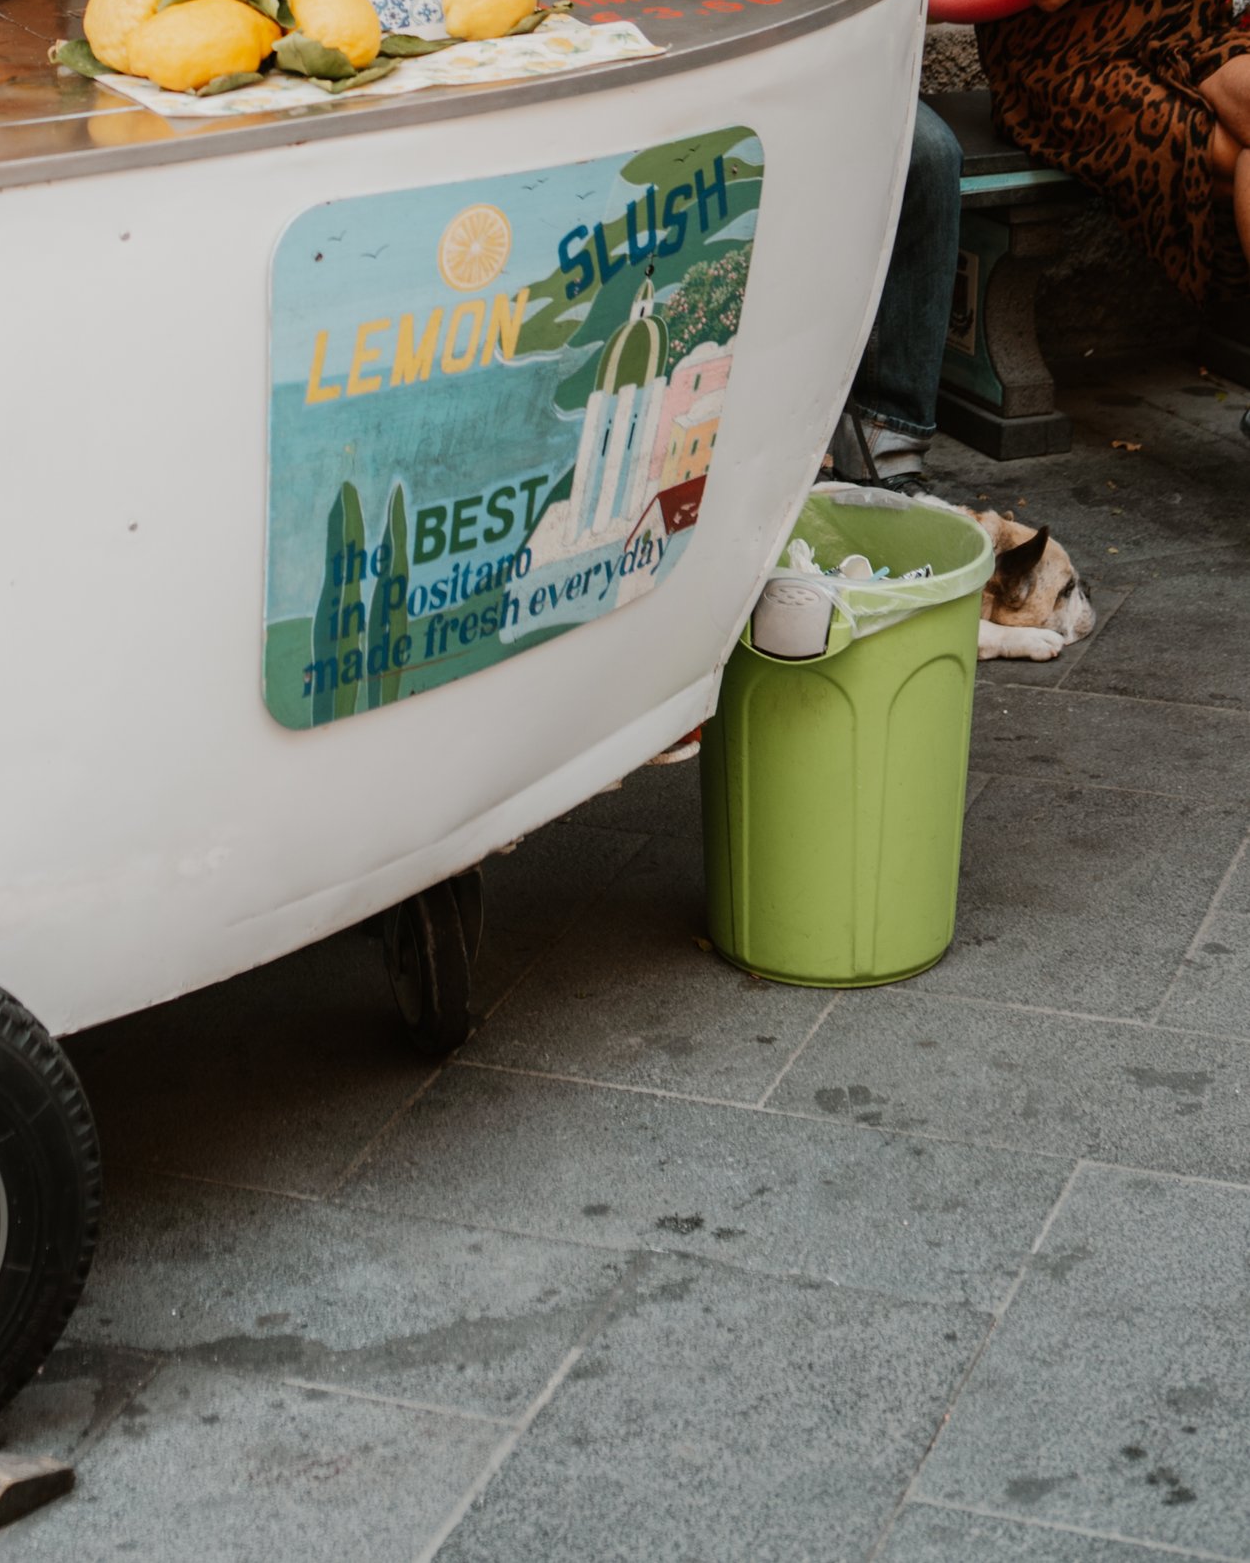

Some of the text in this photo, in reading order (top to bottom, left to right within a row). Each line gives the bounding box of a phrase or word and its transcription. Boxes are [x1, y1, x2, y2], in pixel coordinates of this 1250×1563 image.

[558, 154, 727, 301] SLUSH
[305, 287, 530, 405] LEMON
[331, 540, 391, 589] the
[412, 474, 548, 566] BEST
[302, 532, 671, 698] made fresh everyday
[329, 600, 365, 643] in
